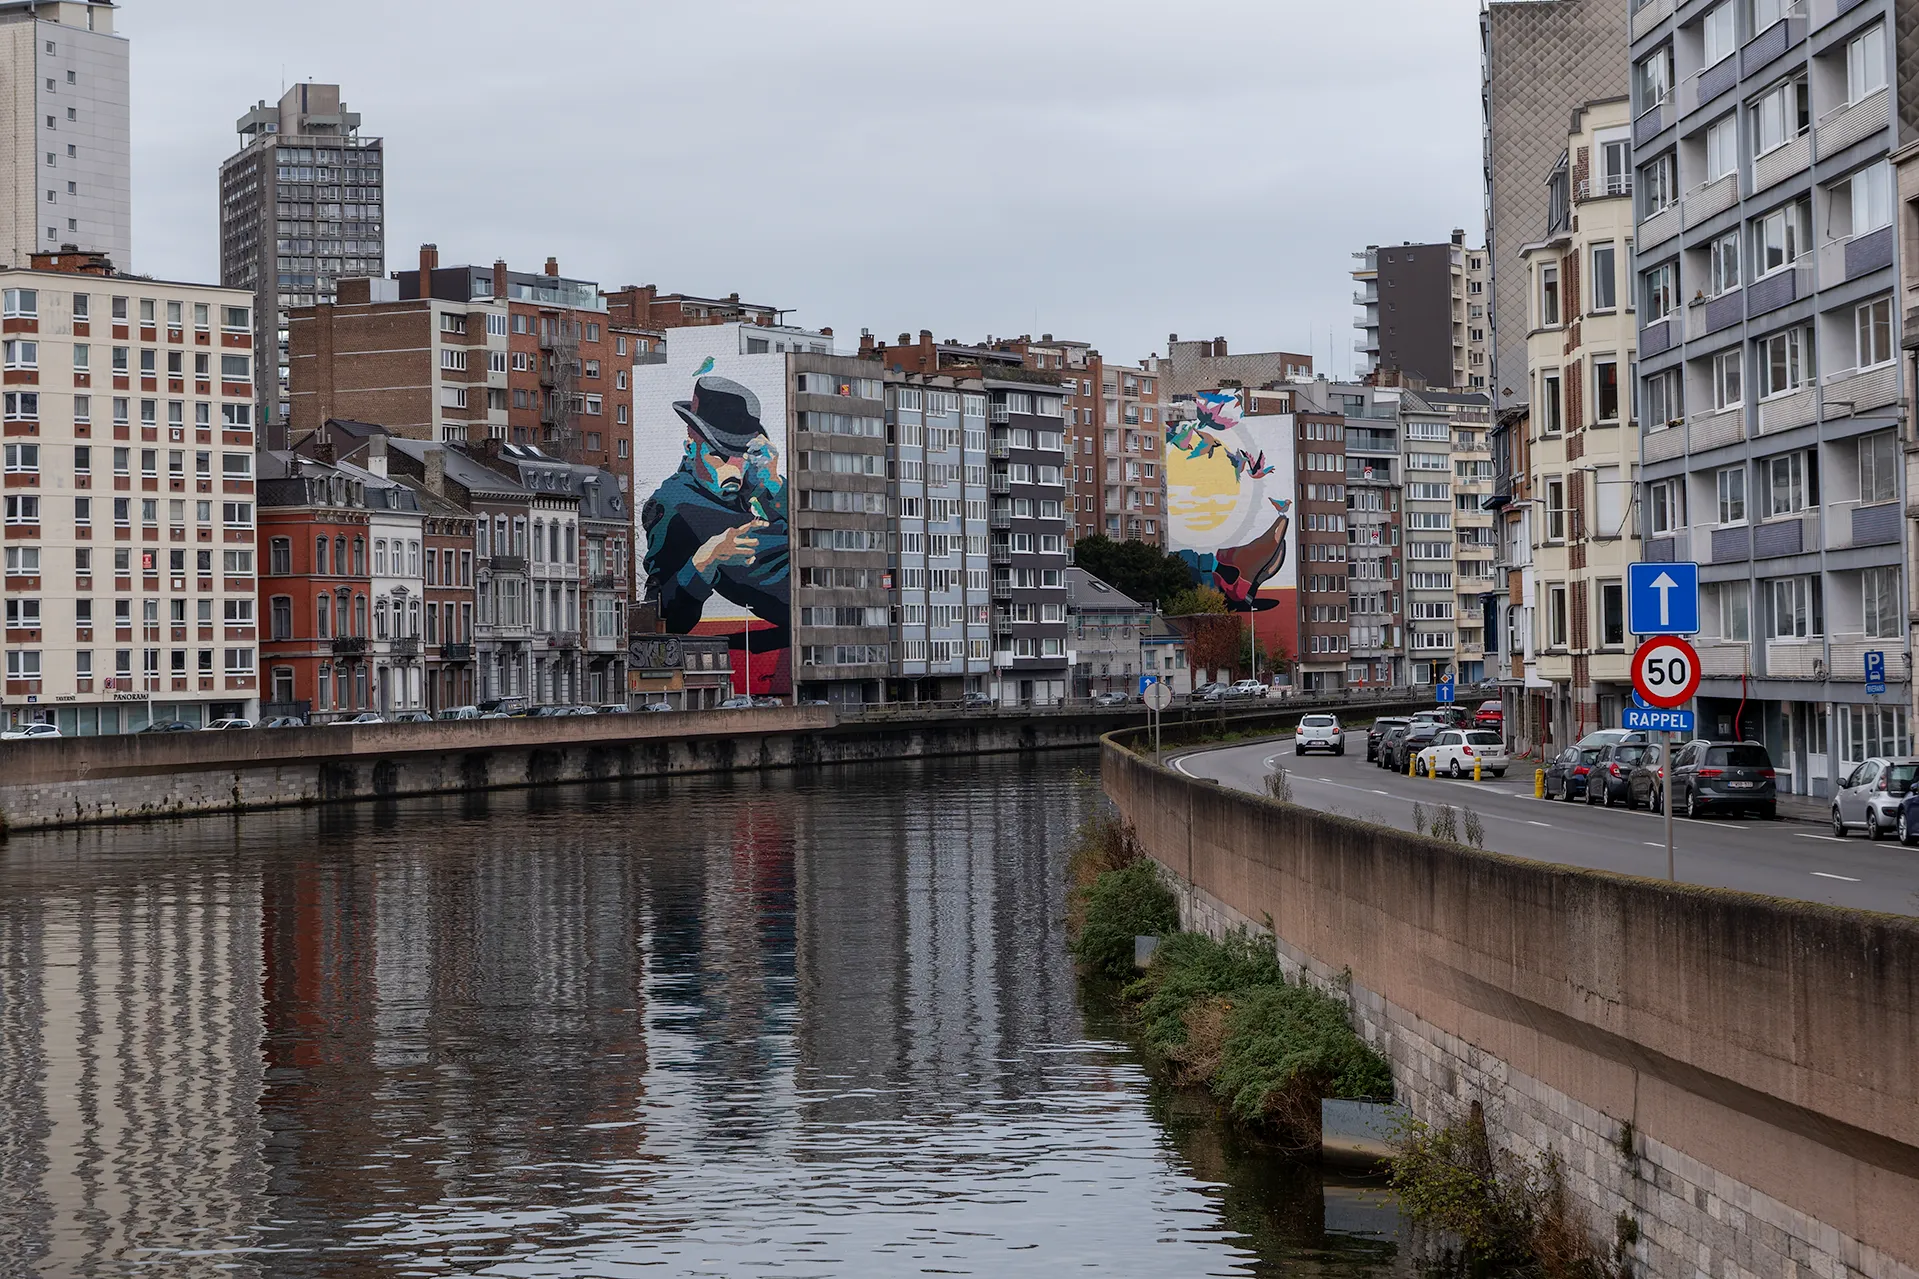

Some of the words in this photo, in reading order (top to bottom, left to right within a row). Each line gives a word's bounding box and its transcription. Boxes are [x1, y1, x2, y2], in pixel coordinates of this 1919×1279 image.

[1868, 654, 1880, 670] P
[1648, 658, 1685, 685] 50
[1629, 712, 1687, 728] RAPPEL
